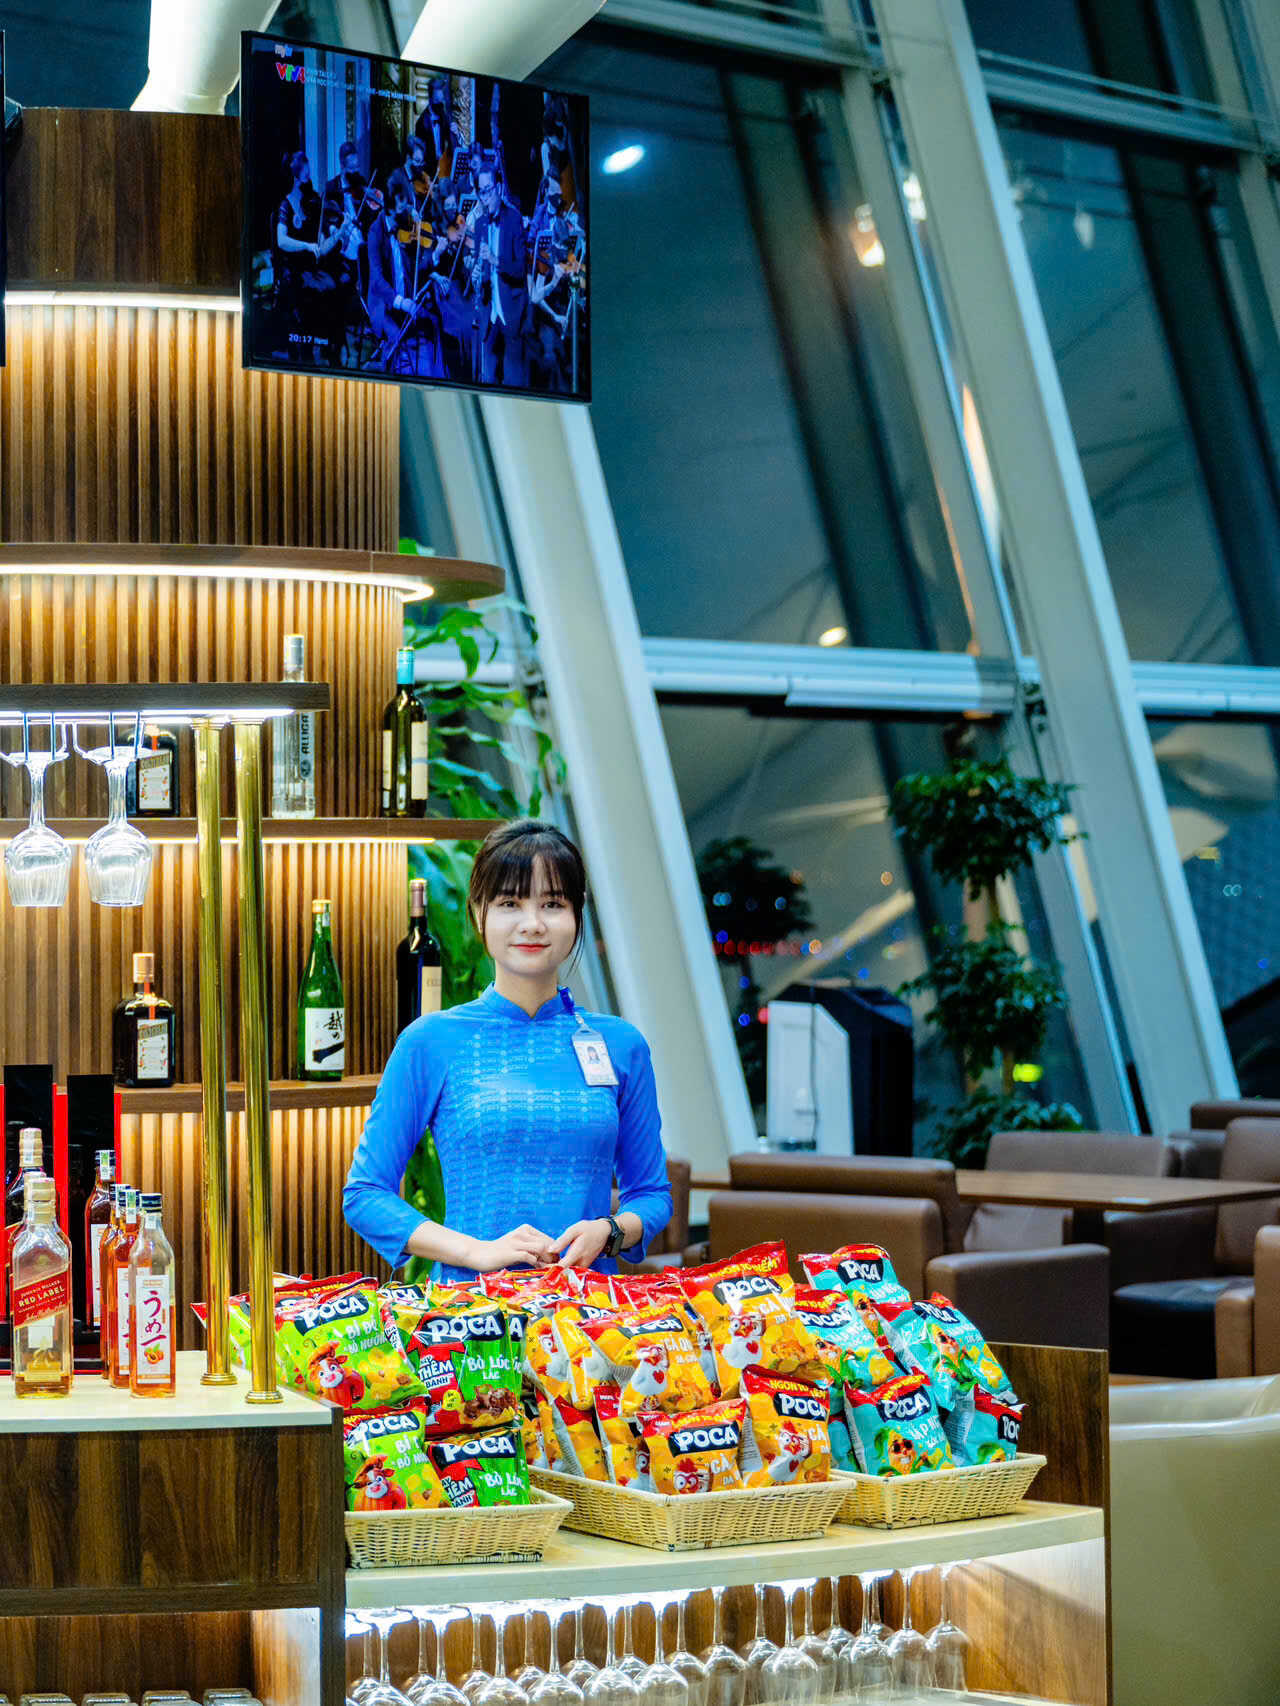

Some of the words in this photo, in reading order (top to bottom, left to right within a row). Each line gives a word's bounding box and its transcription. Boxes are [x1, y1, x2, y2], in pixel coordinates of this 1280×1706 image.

[19, 1296, 36, 1307] RED
[37, 1286, 64, 1300] LABEL
[302, 1296, 366, 1328] POCA
[428, 1314, 502, 1342] POCA
[420, 1360, 454, 1380] THÊM
[440, 1436, 515, 1463] POCA
[675, 1426, 738, 1451] POCA
